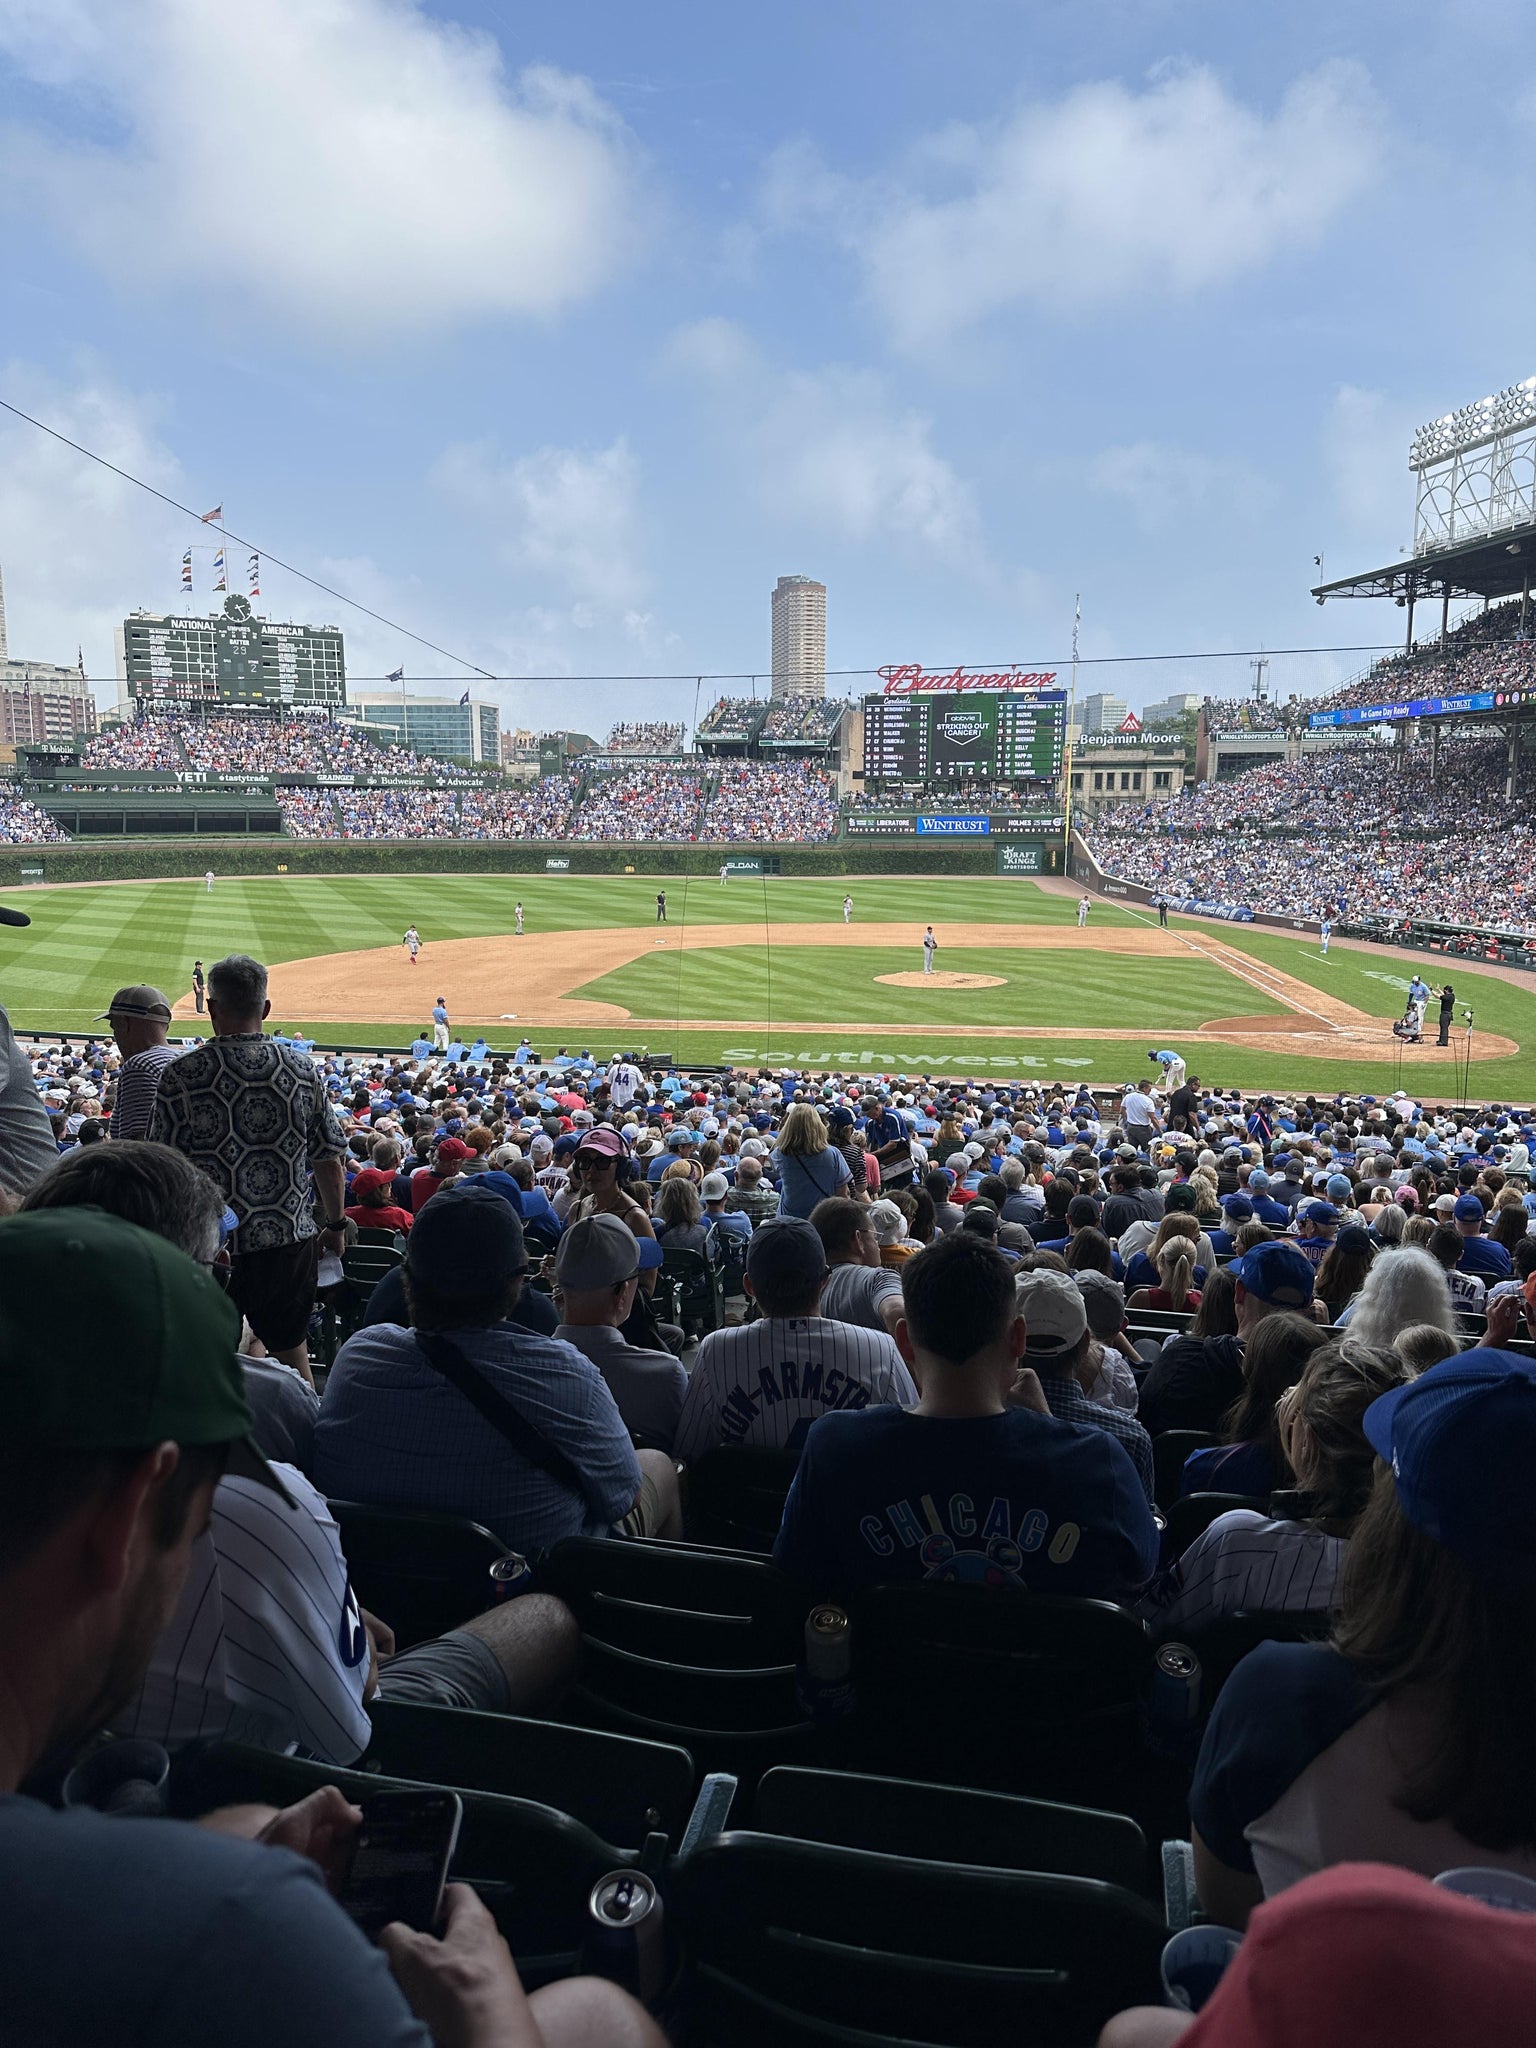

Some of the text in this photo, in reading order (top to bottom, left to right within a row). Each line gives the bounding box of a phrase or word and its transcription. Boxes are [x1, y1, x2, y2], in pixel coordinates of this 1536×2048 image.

[171, 620, 216, 630] NATIONAL
[261, 626, 304, 636] AMERICAN
[233, 646, 246, 655] 29
[250, 664, 257, 673] 2
[878, 664, 1056, 694] Budweiser
[1441, 699, 1472, 709] WINTRUST
[1368, 710, 1382, 718] Game
[1383, 708, 1392, 718] Day
[1393, 705, 1410, 715] Ready
[1080, 733, 1181, 746] Benjamin Moore
[50, 745, 74, 754] Mobile
[175, 772, 206, 782] YETI
[225, 774, 269, 784] tastytrade
[922, 819, 983, 829] WINTRUST
[1004, 852, 1037, 860] DRAFT
[720, 1048, 1048, 1067] Southwest
[615, 1073, 629, 1086] 44
[860, 1494, 1081, 1564] CHICAGO
